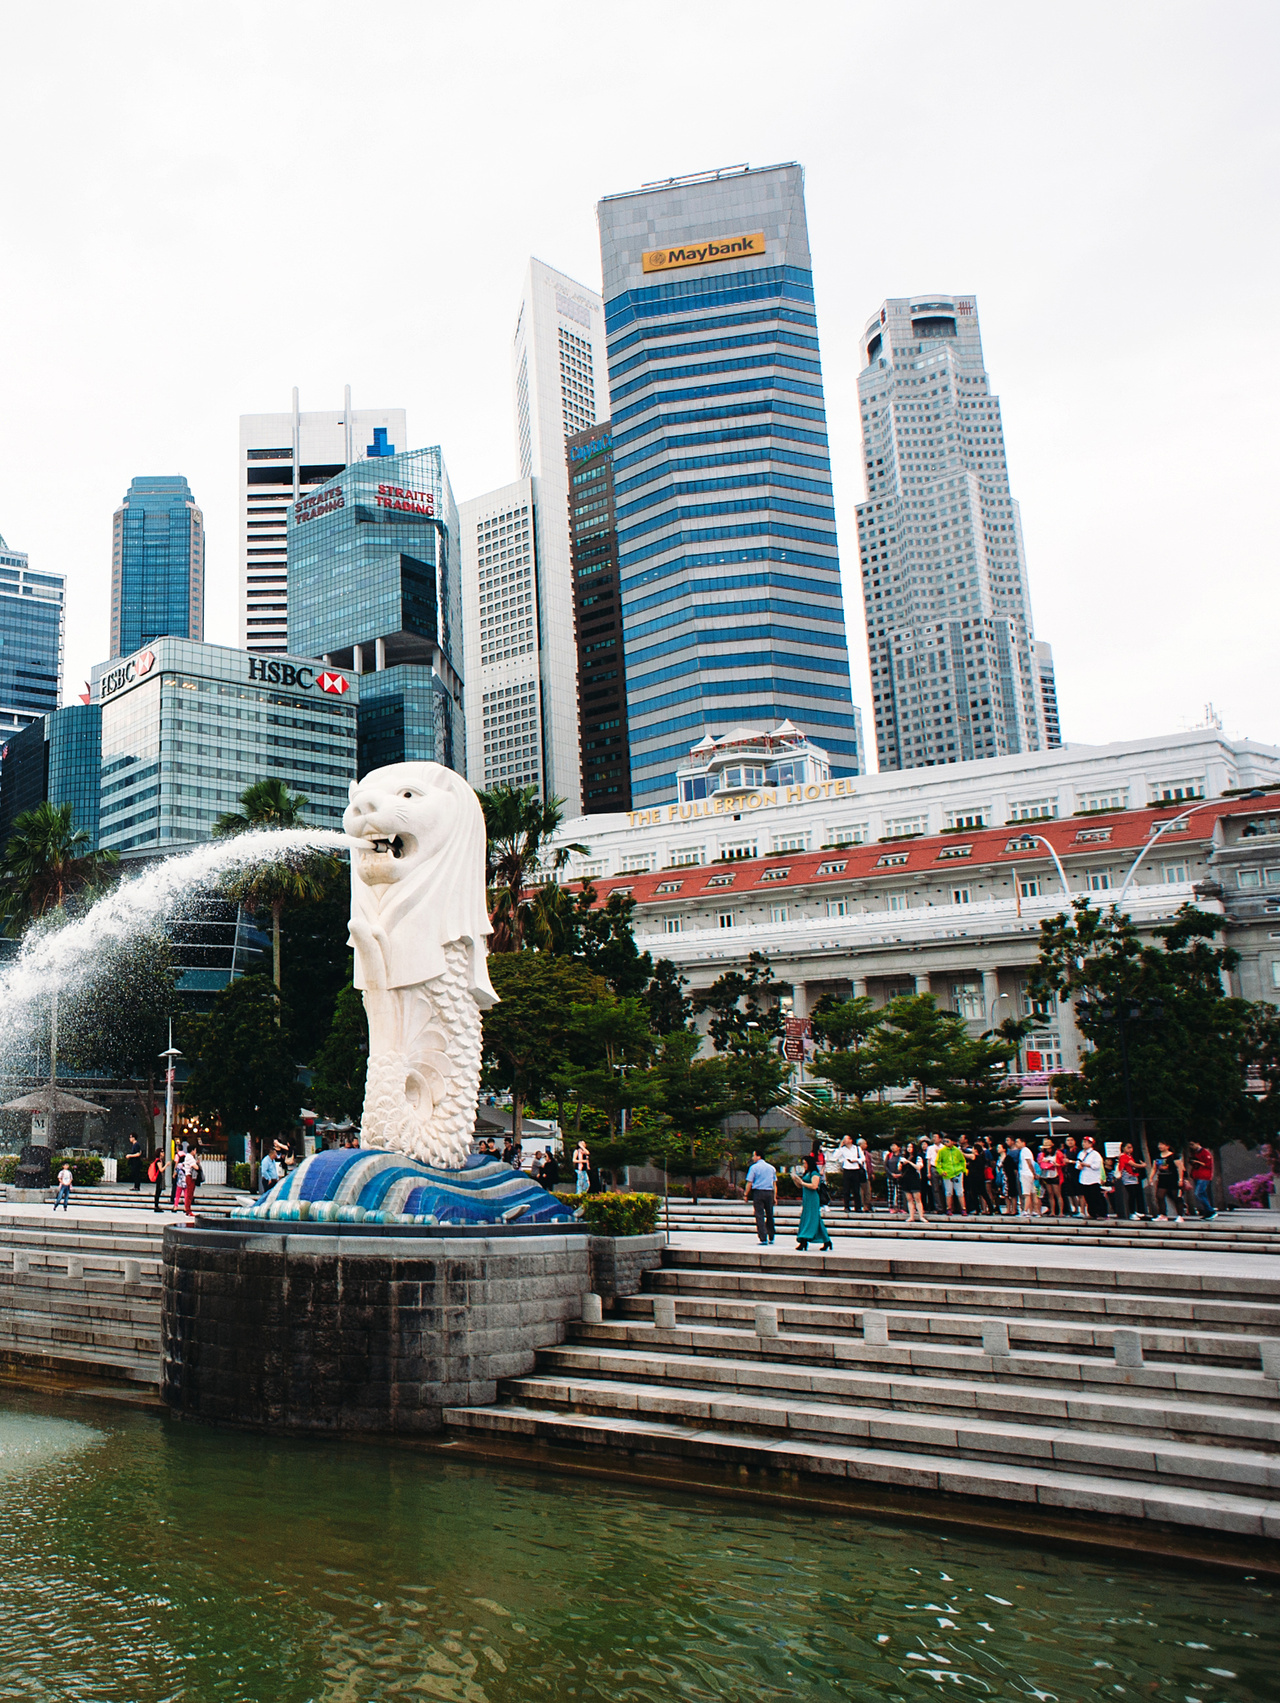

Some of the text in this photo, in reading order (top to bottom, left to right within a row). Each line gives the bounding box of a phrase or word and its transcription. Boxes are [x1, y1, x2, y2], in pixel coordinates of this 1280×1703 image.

[668, 237, 754, 263] Maybank
[294, 486, 343, 513] STRAITS
[374, 495, 435, 516] TRADING
[377, 484, 434, 503] STRAITS
[294, 497, 345, 524] TRADING
[101, 660, 136, 699] HSBC
[248, 656, 314, 689] HSBC
[626, 779, 857, 827] THE FULLERTON HOTEL
